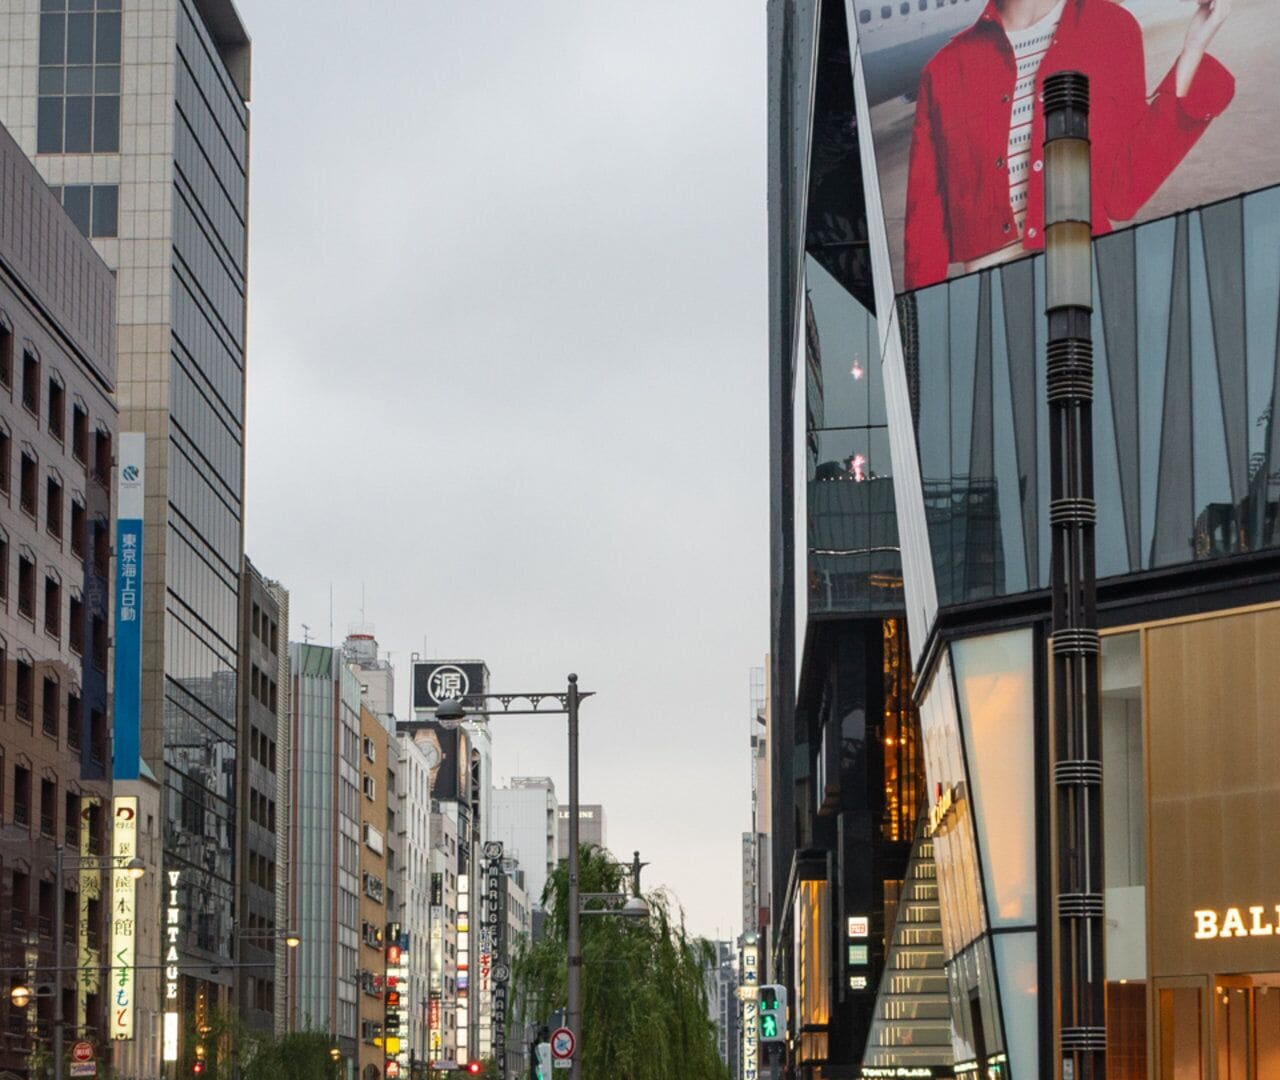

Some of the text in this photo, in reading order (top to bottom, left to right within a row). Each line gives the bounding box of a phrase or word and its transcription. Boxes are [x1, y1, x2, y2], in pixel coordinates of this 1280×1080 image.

[121, 533, 137, 621] 東京海上日動
[433, 672, 462, 700] 源
[115, 947, 130, 1027] くまもと
